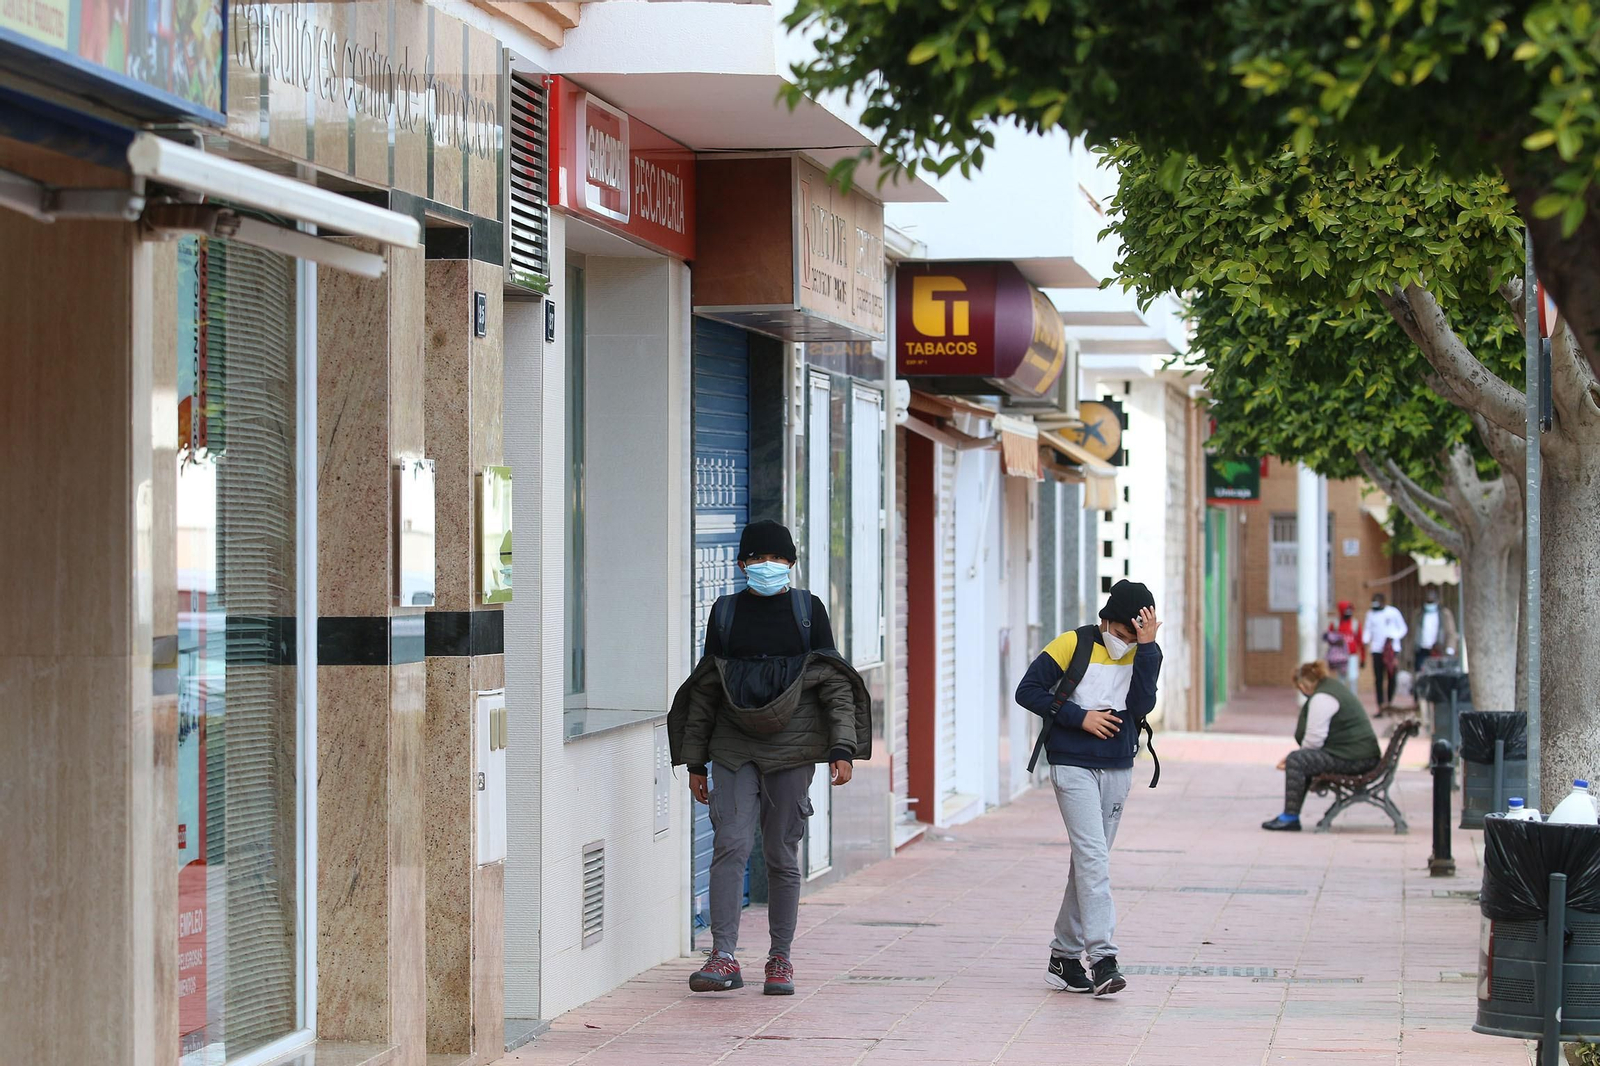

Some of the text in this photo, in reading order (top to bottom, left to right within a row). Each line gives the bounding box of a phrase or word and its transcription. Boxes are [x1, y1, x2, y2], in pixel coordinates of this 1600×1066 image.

[234, 0, 337, 103] consultores
[343, 31, 392, 124] centro
[397, 45, 419, 135] de
[424, 54, 496, 163] formación
[634, 156, 686, 235] PESCADERÍA
[905, 342, 978, 355] TABACOS
[179, 908, 203, 938] EMPLEO
